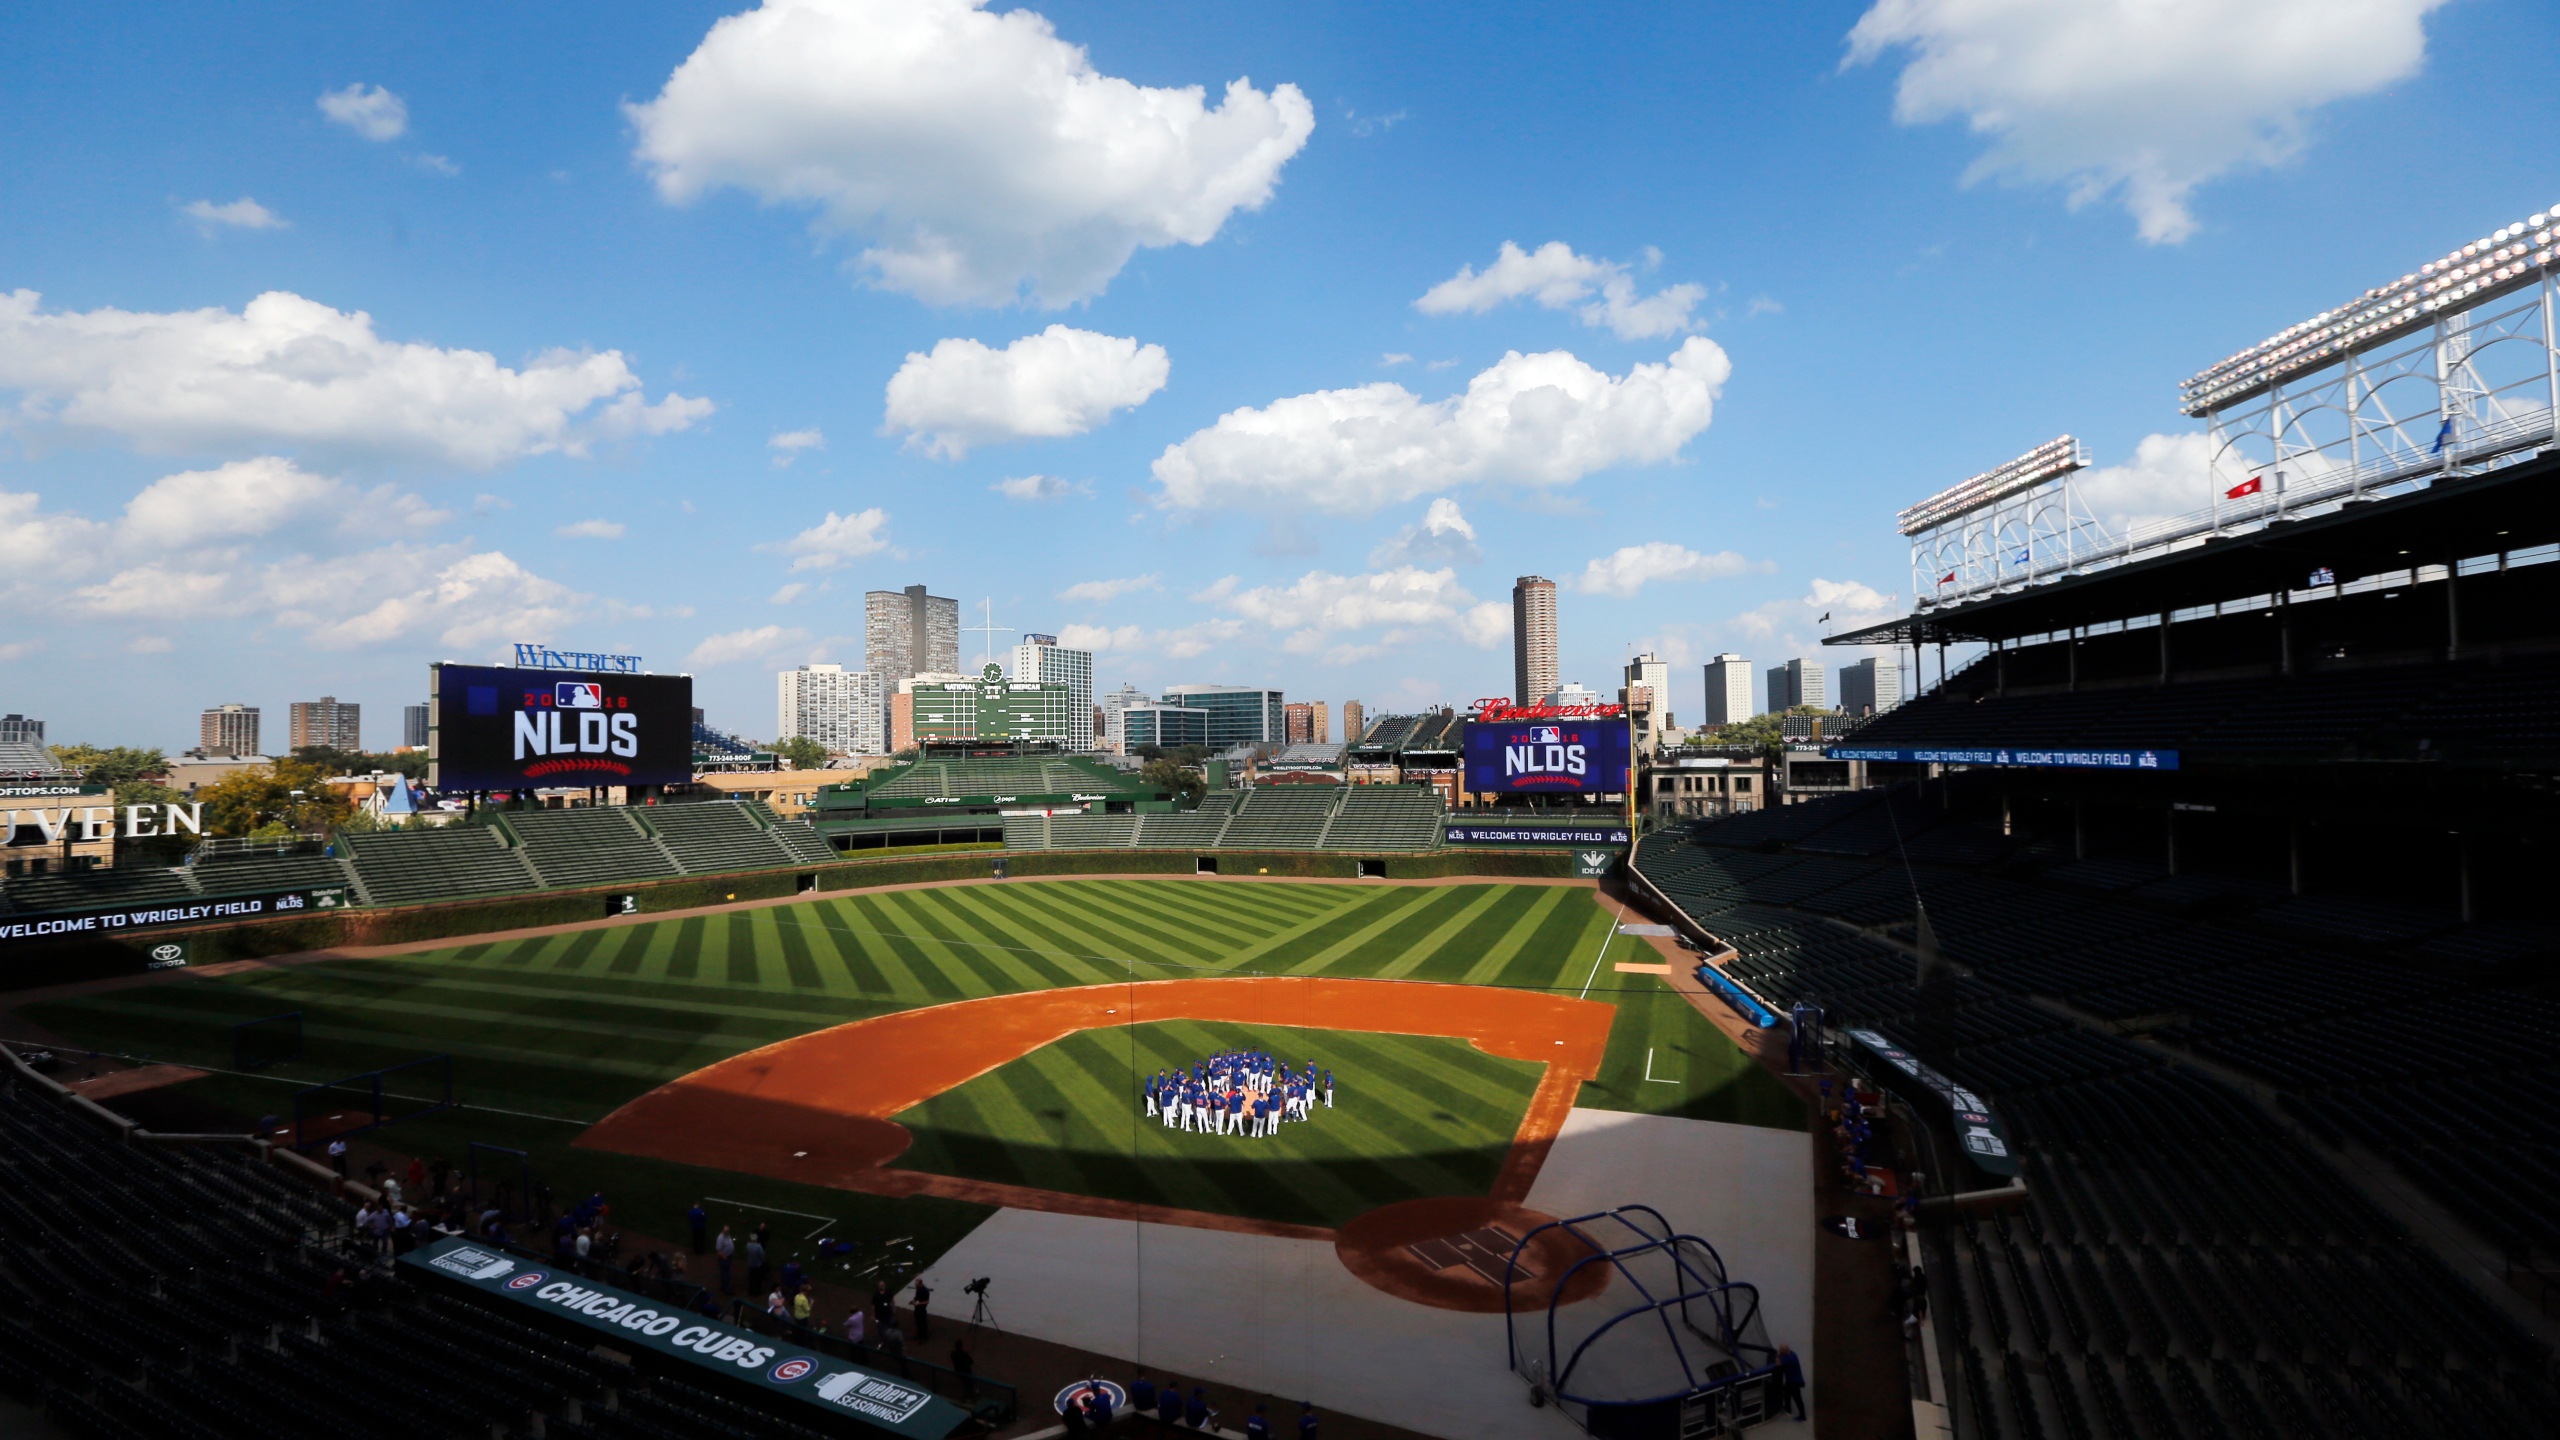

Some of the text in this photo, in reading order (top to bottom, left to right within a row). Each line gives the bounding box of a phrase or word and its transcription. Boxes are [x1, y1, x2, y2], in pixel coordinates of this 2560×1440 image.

[1474, 697, 1624, 723] Budweiser
[514, 710, 638, 761] NLDS
[1506, 744, 1586, 777] NLDS
[1914, 751, 1940, 761] WELCOME
[1949, 752, 1974, 762] WRIGLEY
[1974, 752, 1992, 762] FIELD
[2016, 752, 2131, 766] WELCOME TO WRIGLEY FIELD
[1471, 831, 1602, 842] WELCOME TO WRIGLEY FIELD
[100, 913, 127, 929] TO
[130, 905, 212, 925] WRIGLEY
[215, 900, 262, 916] FIELD
[148, 958, 187, 969] TOYOTA
[536, 1282, 776, 1368] CHICAGO CUBS
[858, 1380, 909, 1403] weber
[837, 1394, 904, 1423] SEASONINGS
